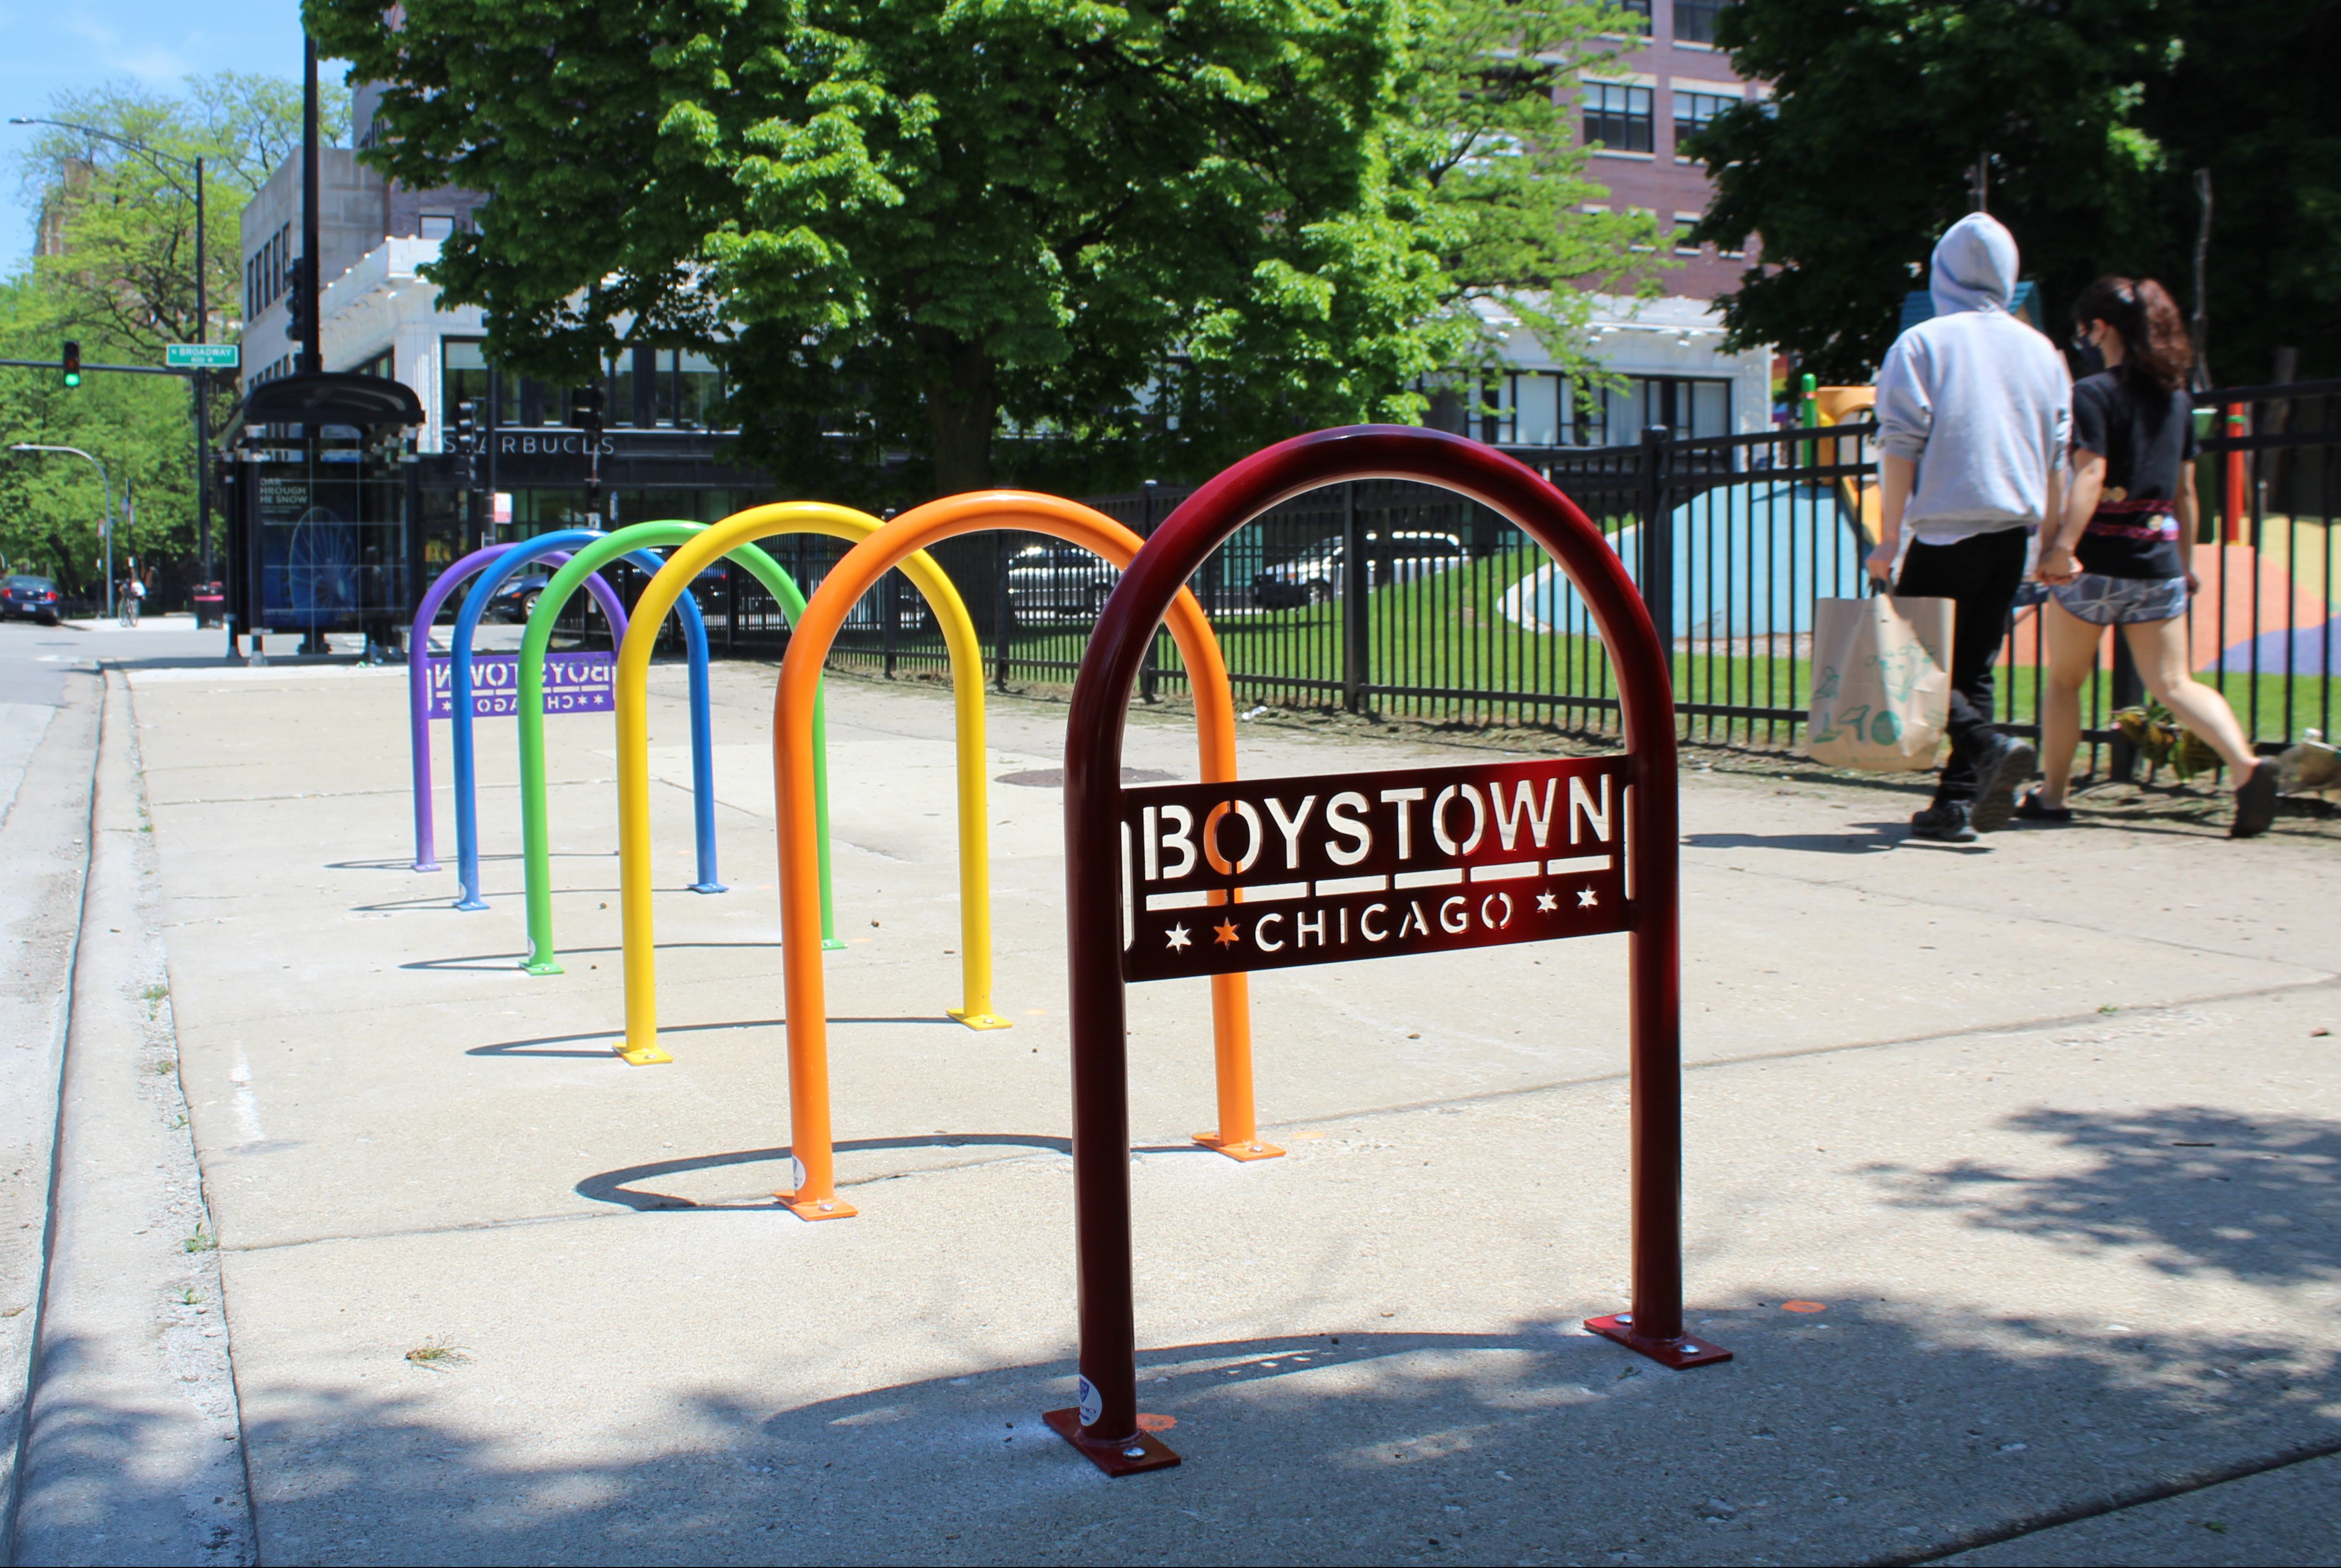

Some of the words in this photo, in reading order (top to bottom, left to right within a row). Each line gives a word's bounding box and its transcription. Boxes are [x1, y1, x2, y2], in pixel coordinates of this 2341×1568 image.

[179, 347, 231, 357] BROADWAY
[444, 434, 614, 454] SARBUCS
[1142, 774, 1612, 881] BOYSTOWN
[1255, 891, 1514, 952] CHICAGO
